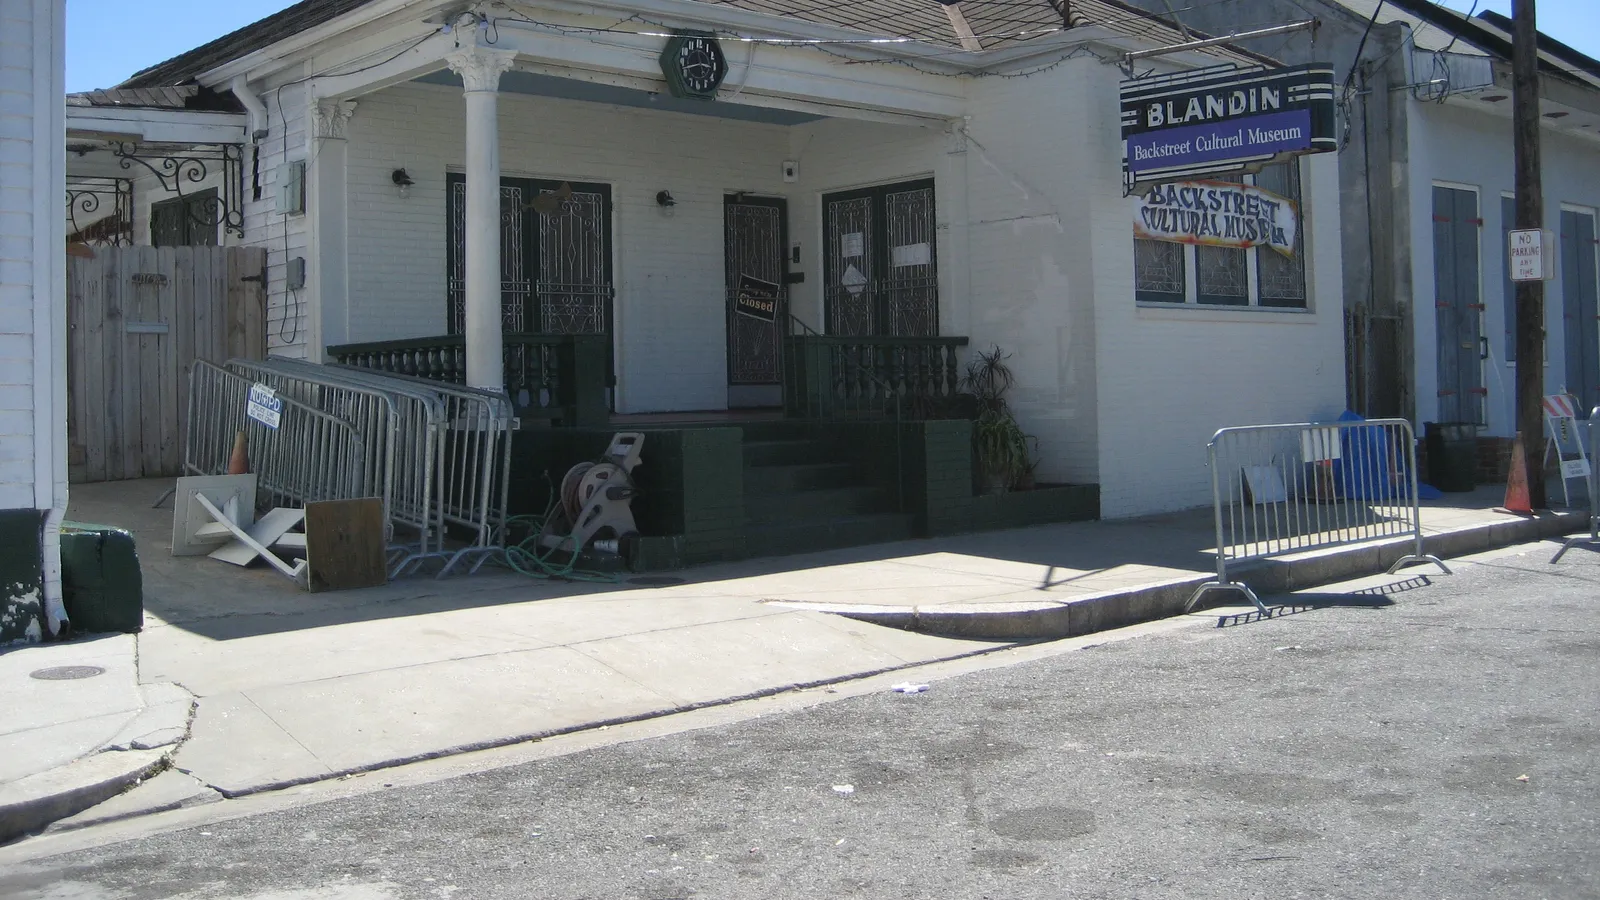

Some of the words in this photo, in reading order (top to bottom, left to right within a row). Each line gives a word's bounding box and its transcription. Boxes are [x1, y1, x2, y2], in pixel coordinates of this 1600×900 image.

[696, 39, 703, 49] 12
[681, 47, 689, 56] 10
[710, 51, 715, 60] 2
[688, 77, 693, 87] 7
[695, 80, 701, 90] 6
[1146, 86, 1280, 128] BLANDIN
[1134, 139, 1191, 161] Backstreet
[1195, 128, 1243, 152] Cultural
[1248, 126, 1302, 146] Museum
[1148, 183, 1281, 224] BACKSTREET
[1140, 205, 1222, 239] CULTURAL
[1224, 214, 1289, 246] MUSEM
[1519, 234, 1532, 245] NO
[1511, 246, 1540, 257] PARKING
[1519, 268, 1534, 276] TIME
[739, 292, 774, 313] Closed
